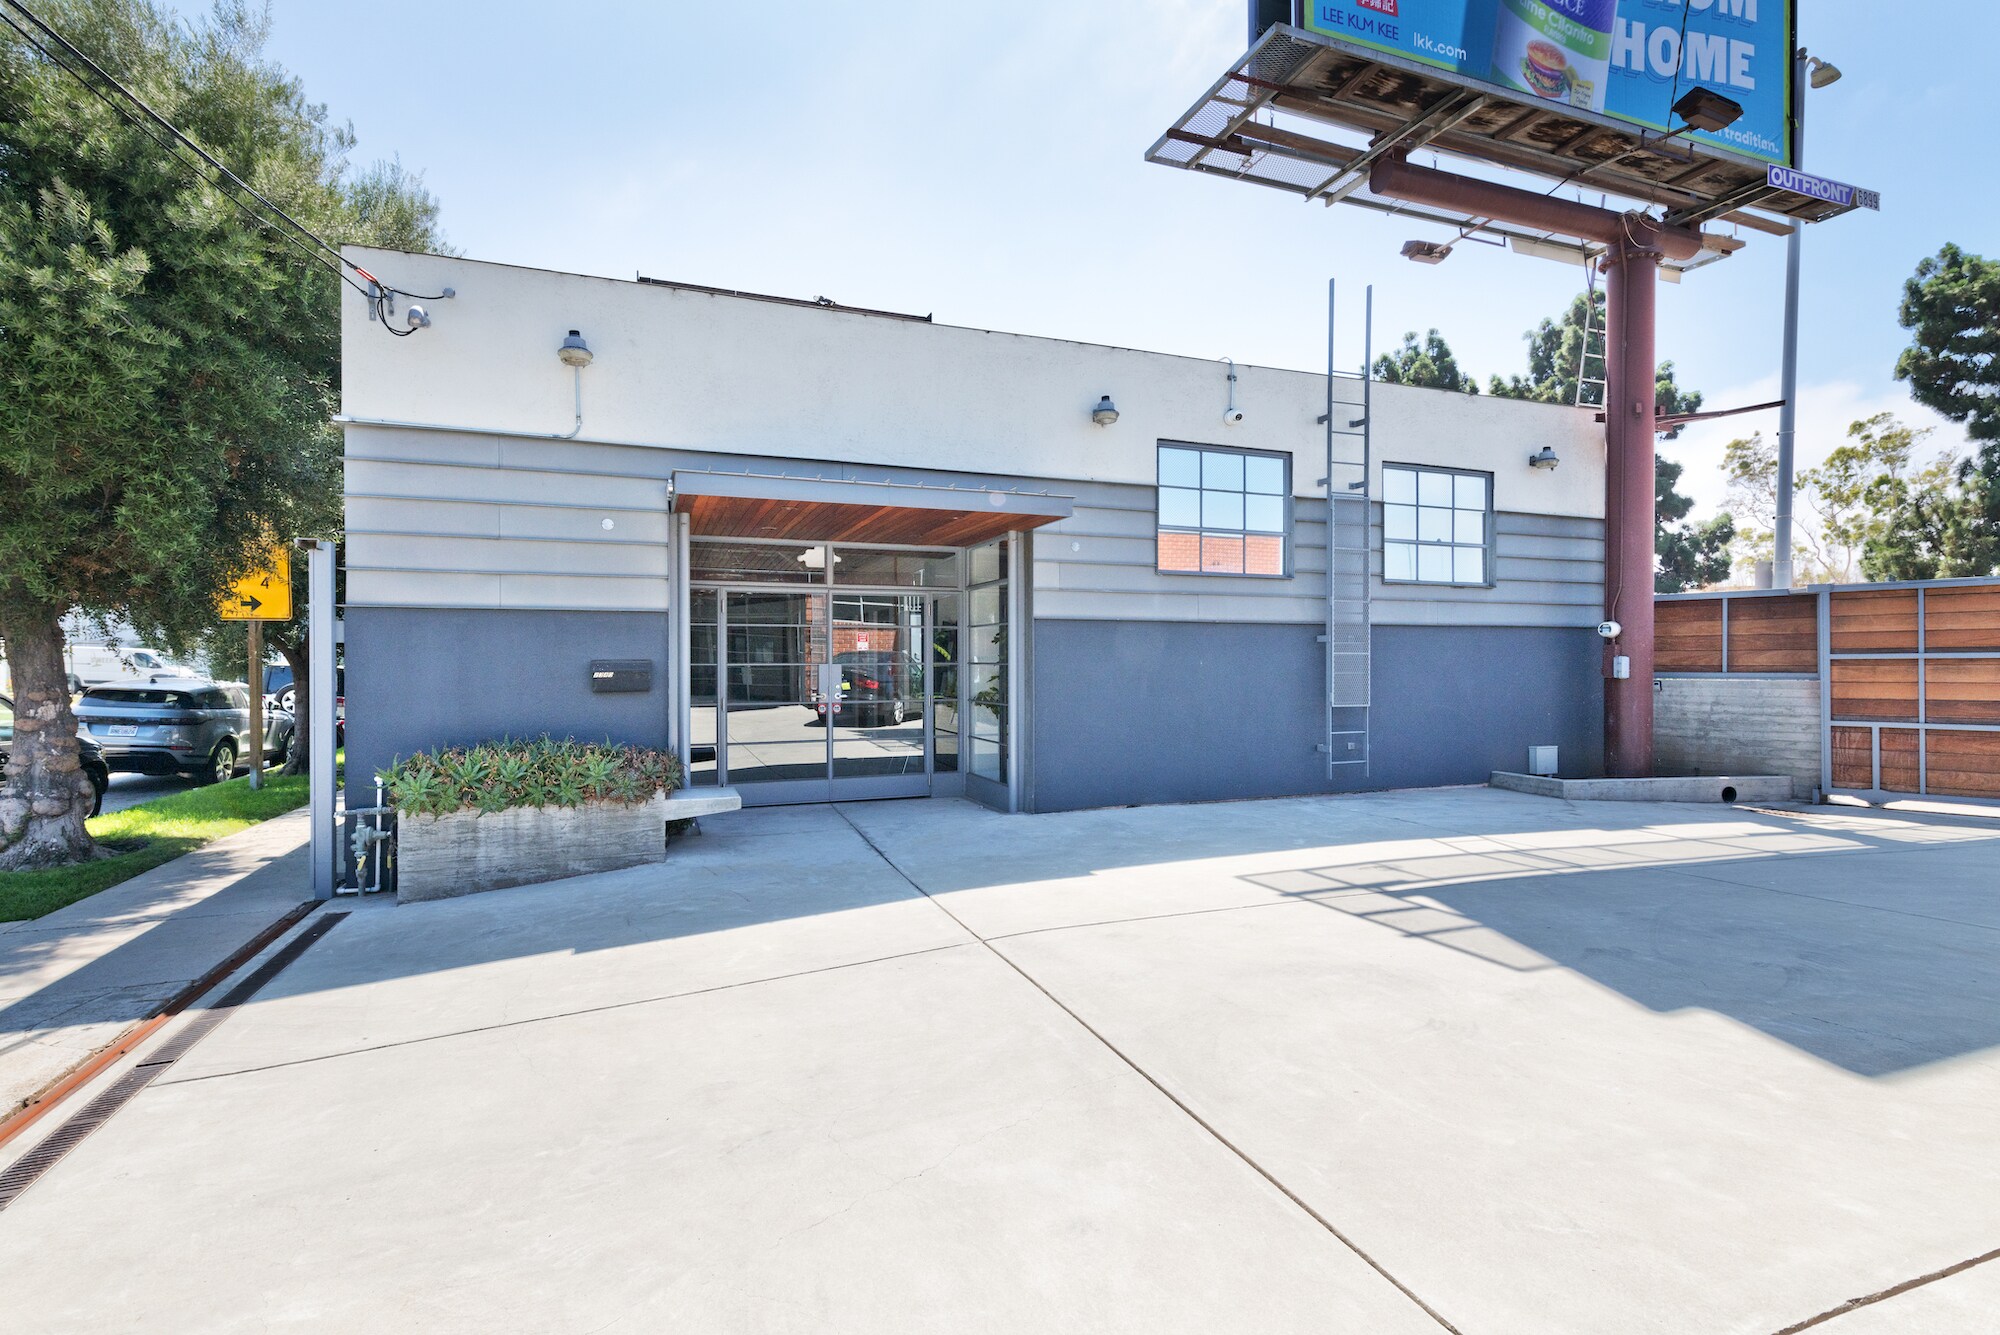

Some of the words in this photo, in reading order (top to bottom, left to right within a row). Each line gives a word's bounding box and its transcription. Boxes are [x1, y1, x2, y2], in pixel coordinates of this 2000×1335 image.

[1323, 6, 1343, 25] LEE
[1348, 13, 1374, 33] KUM
[1378, 22, 1399, 41] KEE
[1548, 11, 1594, 45] Cilantro
[1413, 31, 1467, 61] lkk.com
[1611, 16, 1755, 90] HOME
[1724, 126, 1779, 154] tradition.
[1771, 167, 1850, 204] OUTFRONT
[1858, 189, 1878, 209] 6899
